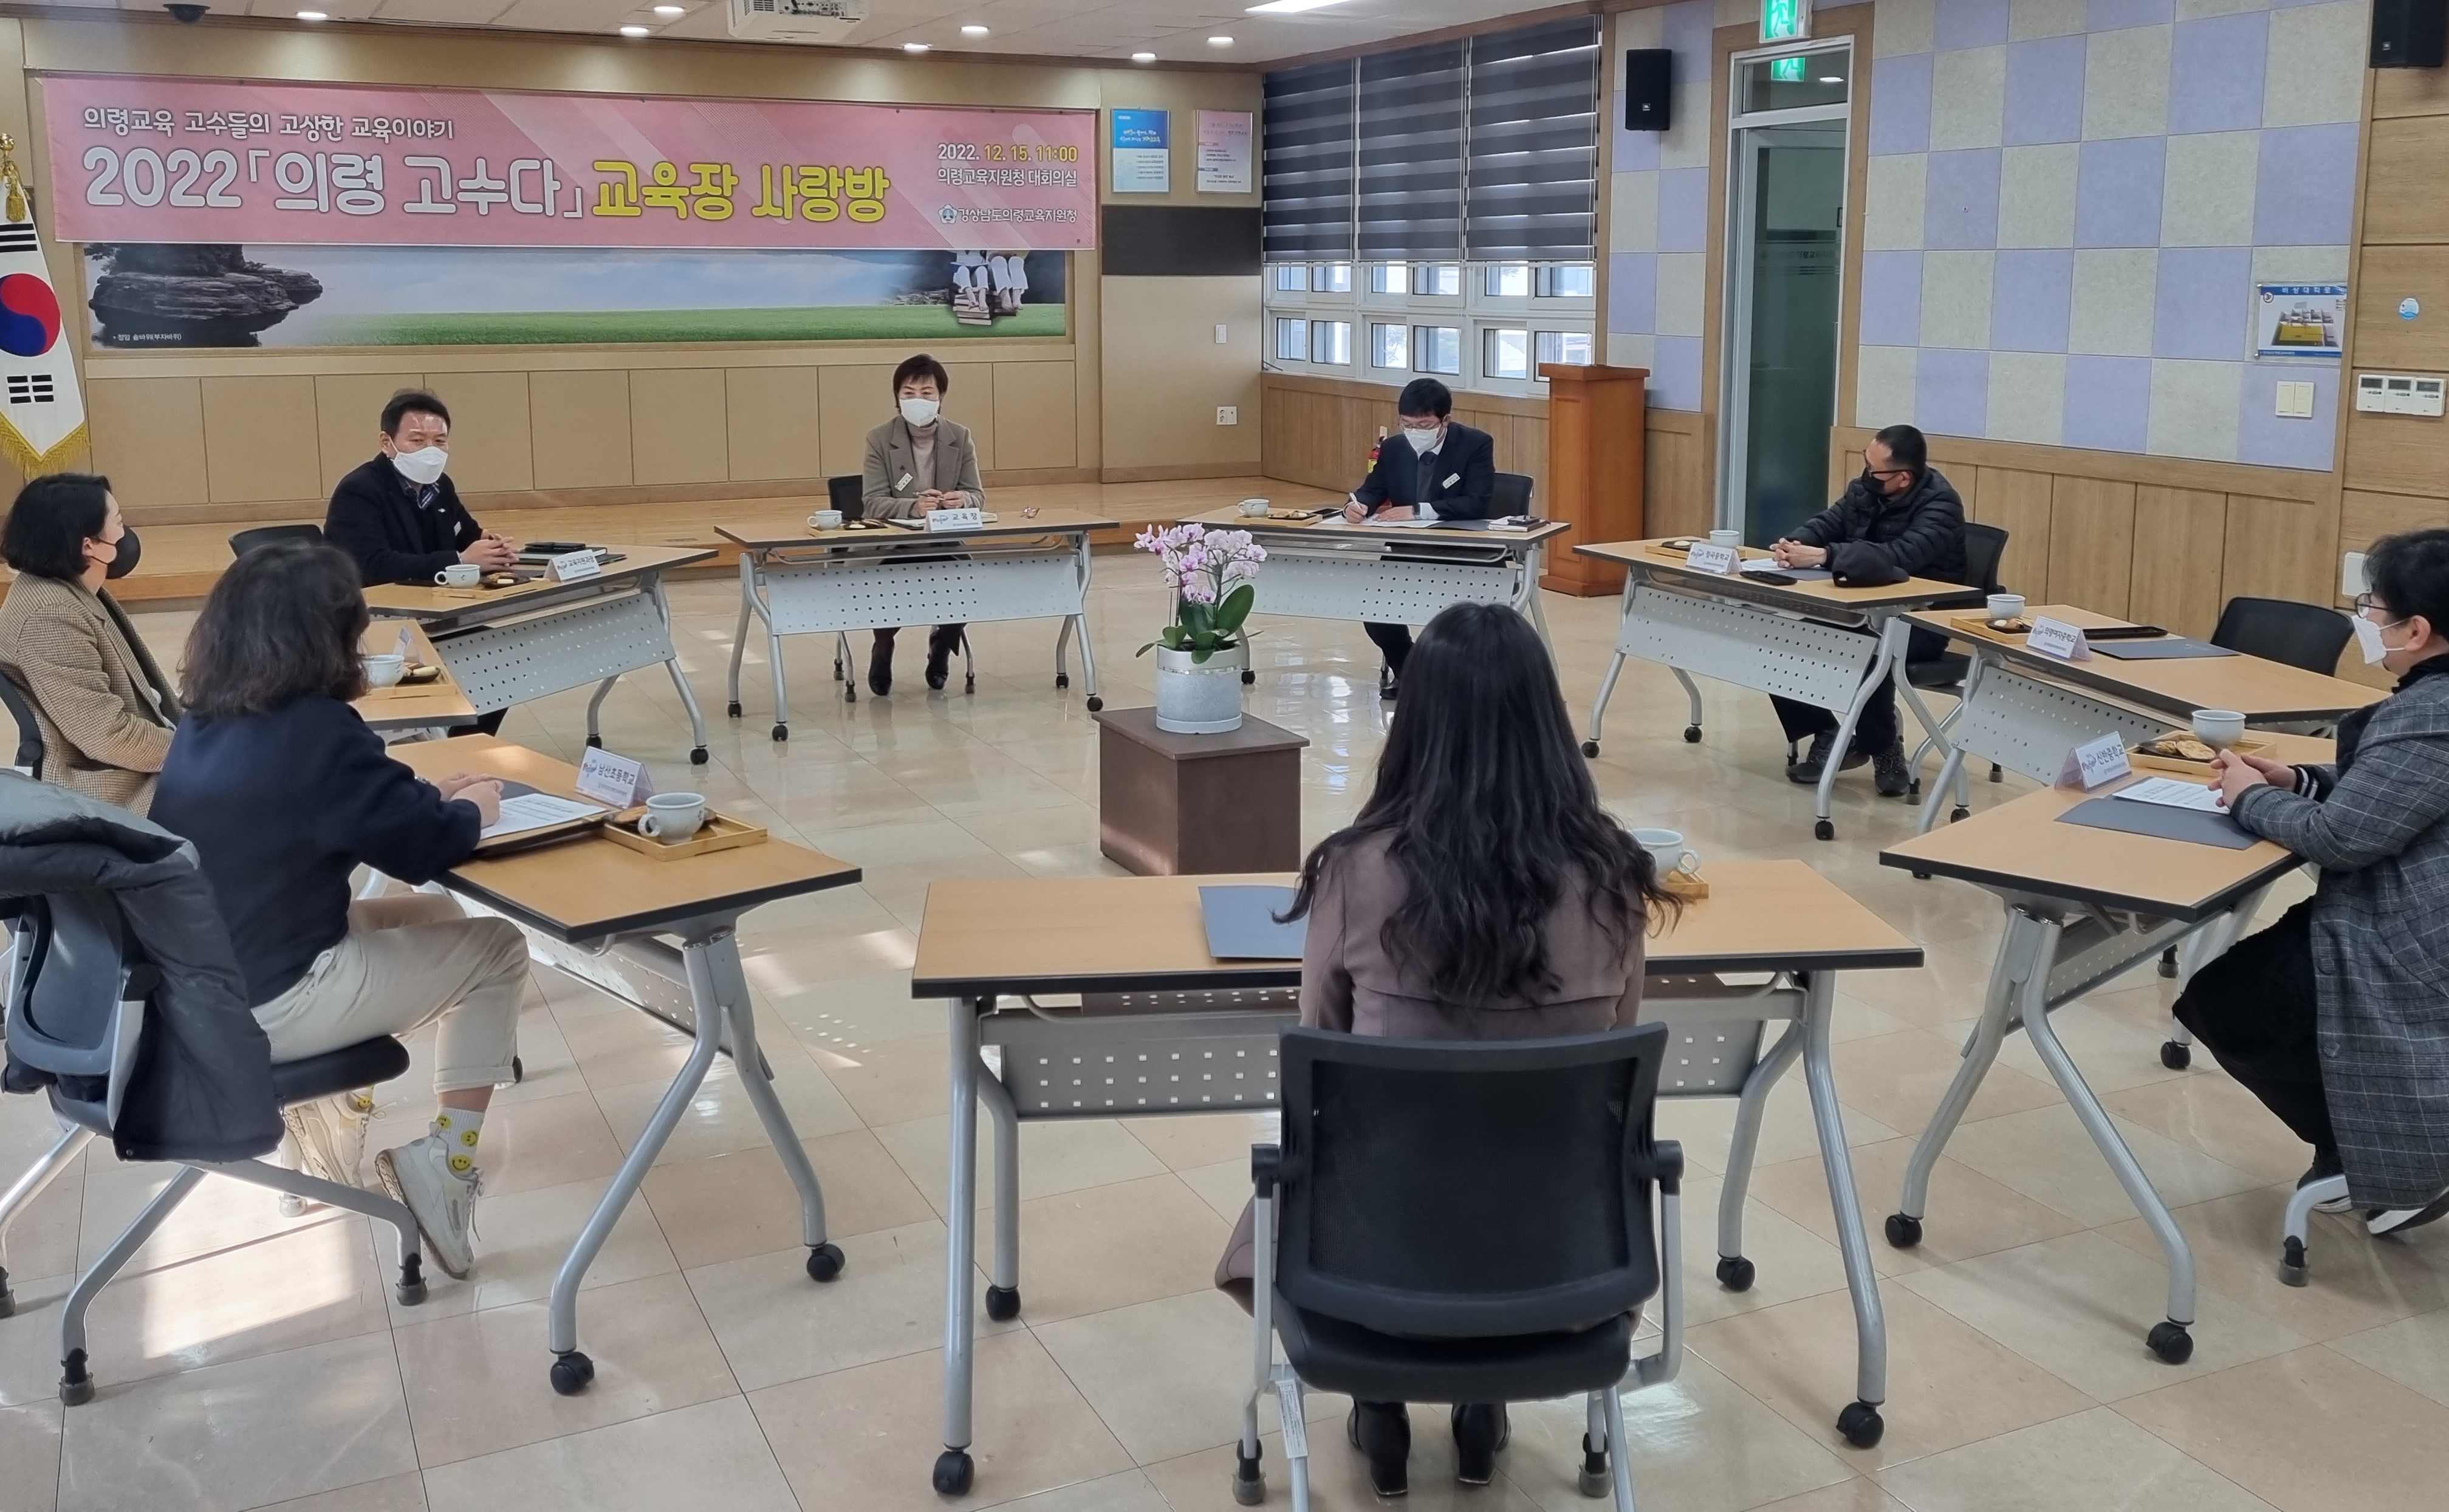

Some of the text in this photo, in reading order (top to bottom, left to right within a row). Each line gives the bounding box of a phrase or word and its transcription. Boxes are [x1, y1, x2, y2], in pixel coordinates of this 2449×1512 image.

[83, 108, 454, 143] 의령교육 고수들의 고상한 교육이야기
[937, 143, 1078, 163] 2022. 12. 15. 11:00
[937, 168, 1077, 187] 의령교육지원청 대회의실
[592, 160, 740, 221] 교육장
[751, 165, 891, 223] 사랑방
[958, 208, 1077, 224] 경상남도의령교육지원청
[598, 762, 635, 785] 남산초등학교
